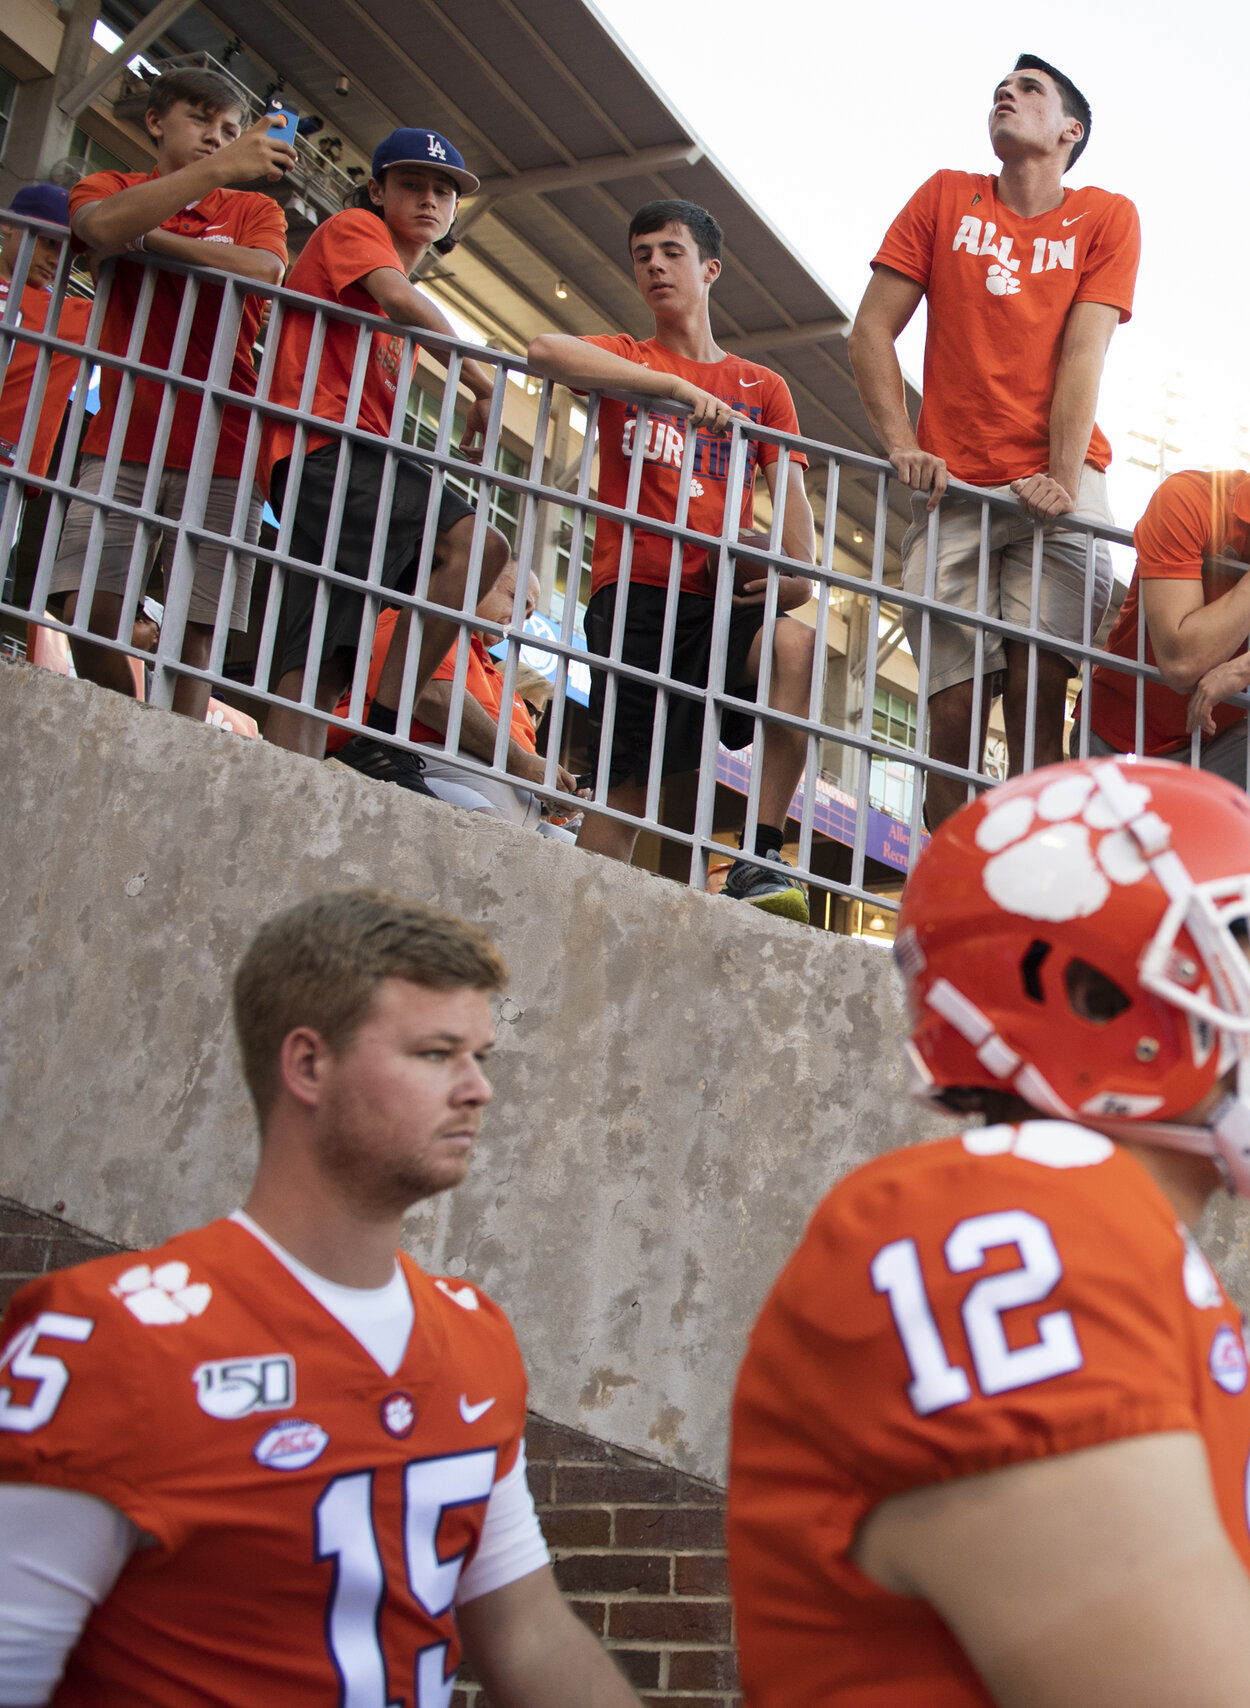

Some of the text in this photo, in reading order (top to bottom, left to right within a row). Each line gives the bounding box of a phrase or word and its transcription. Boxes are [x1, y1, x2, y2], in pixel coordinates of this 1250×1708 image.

[427, 134, 446, 161] LA
[952, 215, 1076, 273] ALL IN
[869, 1208, 1084, 1418] 12
[203, 1358, 291, 1416] 150
[264, 1427, 317, 1460] ACC
[313, 1444, 498, 1708] 15
